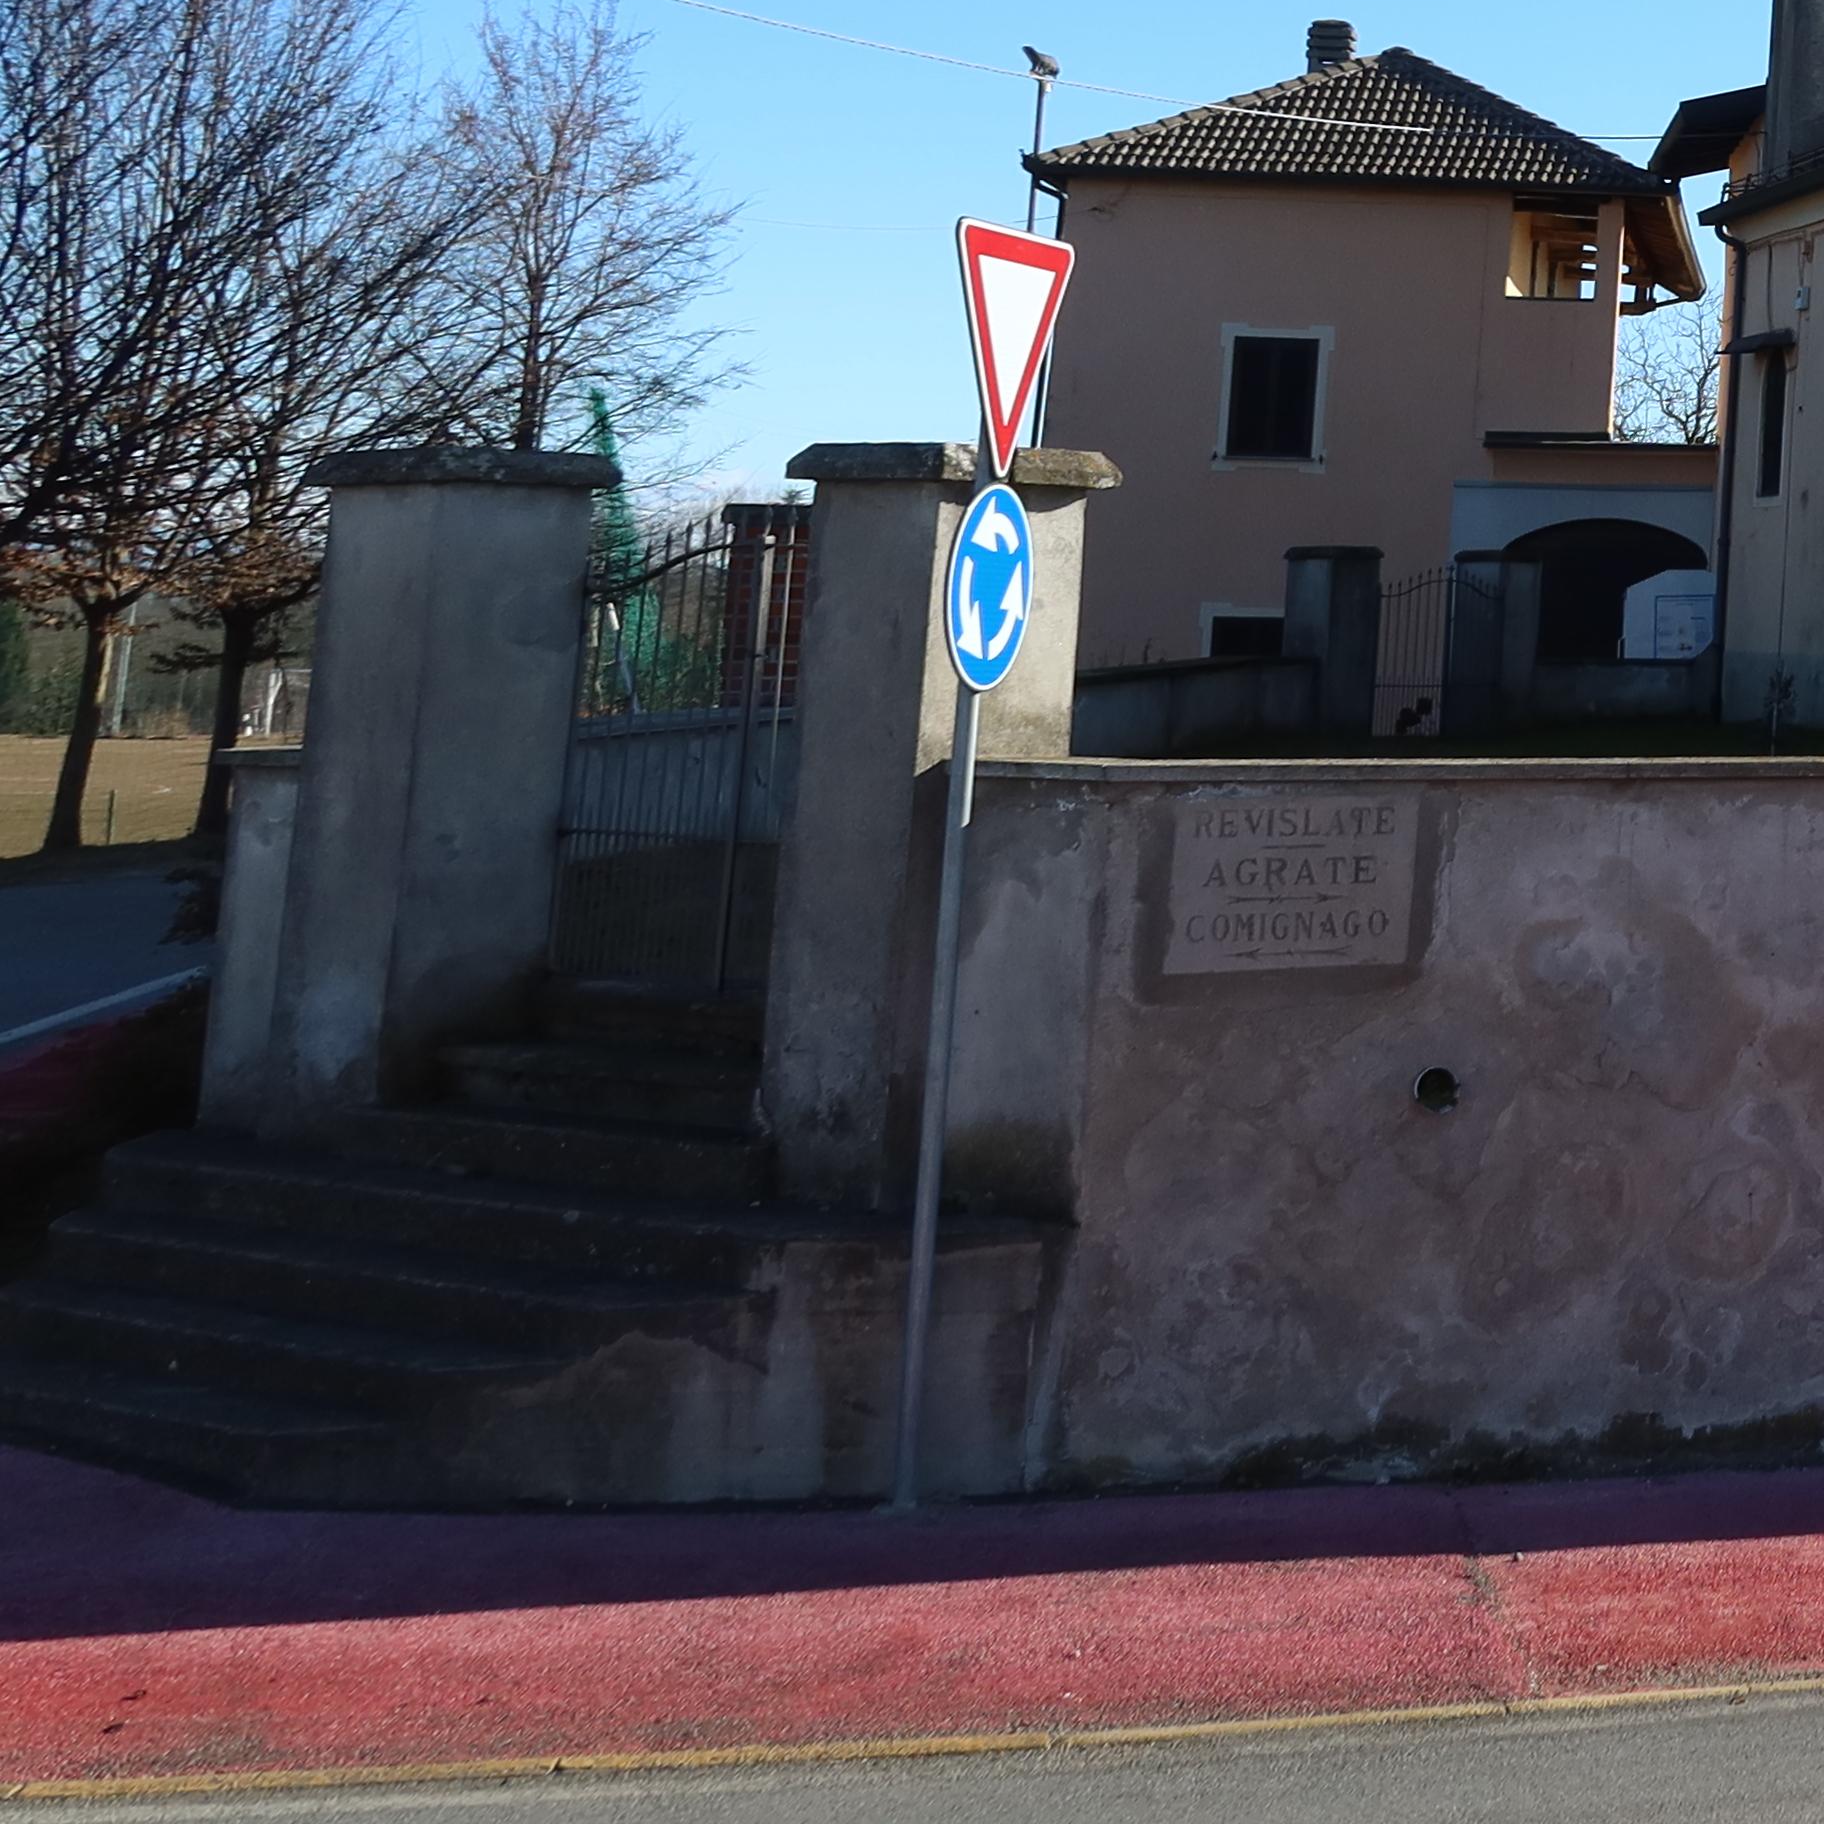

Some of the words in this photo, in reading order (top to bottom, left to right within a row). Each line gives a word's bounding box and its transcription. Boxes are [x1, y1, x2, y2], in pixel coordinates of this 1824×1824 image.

[1194, 807, 1395, 840] REVISLATE
[1202, 856, 1376, 892] AGRATE
[1185, 909, 1389, 943] COMIGNAGO
